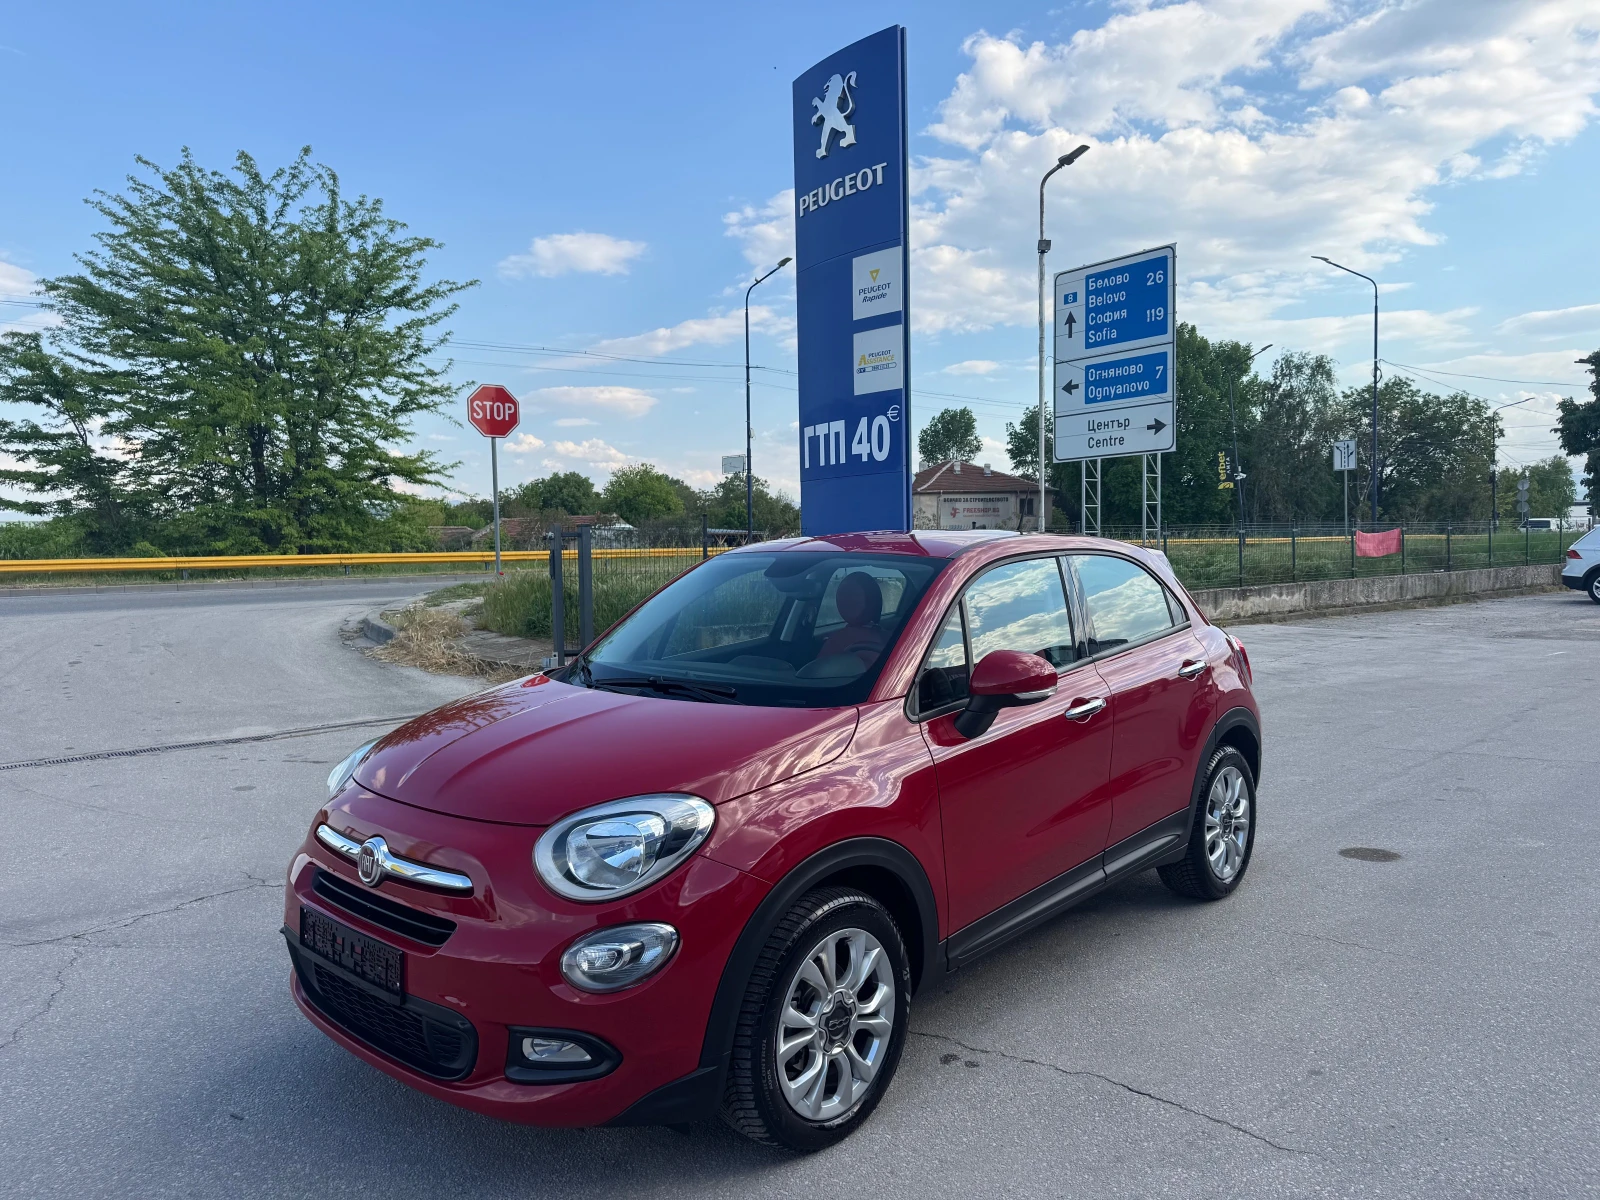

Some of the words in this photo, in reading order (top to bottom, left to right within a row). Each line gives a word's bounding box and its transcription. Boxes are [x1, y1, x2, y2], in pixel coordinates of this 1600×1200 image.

[799, 162, 887, 218] PEUGEOT
[858, 282, 891, 296] PEUGEOT
[1089, 272, 1130, 291] Белово
[1146, 270, 1164, 287] 26
[862, 291, 888, 304] Rapide
[1067, 294, 1074, 303] 8
[1089, 290, 1126, 308] Belovo
[1089, 308, 1127, 326] София
[1146, 306, 1164, 323] 119
[1089, 331, 1117, 343] Sofia
[868, 350, 891, 358] PEUGEOT
[1089, 363, 1143, 381] Огняново
[1155, 365, 1164, 379] 7
[1089, 380, 1150, 400] Ognyanovo
[473, 400, 515, 421] STOP
[1088, 417, 1130, 434] Център
[804, 419, 846, 469] ГТП
[1088, 436, 1125, 449] Centre
[1217, 450, 1226, 480] efbet
[362, 854, 373, 873] FIAT
